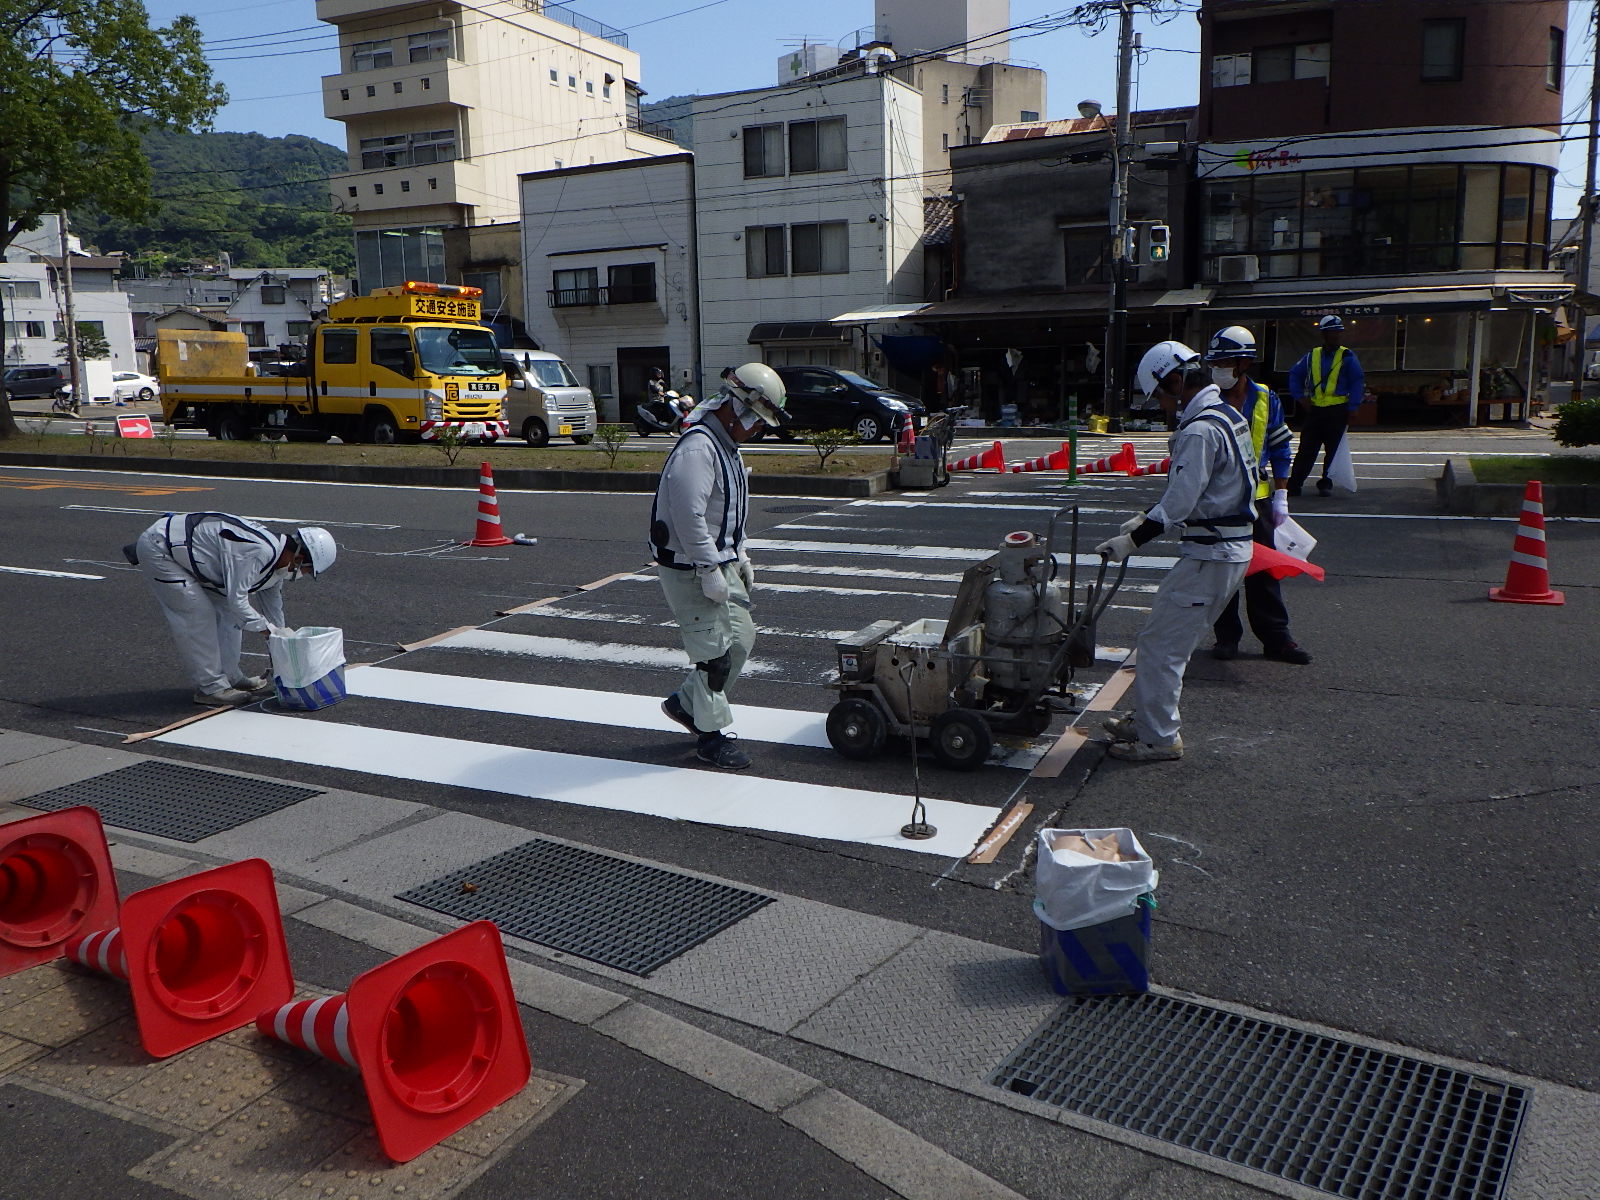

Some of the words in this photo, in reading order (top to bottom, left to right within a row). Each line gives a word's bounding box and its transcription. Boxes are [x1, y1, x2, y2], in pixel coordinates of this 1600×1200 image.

[415, 298, 477, 318] 交通安全施設
[446, 383, 459, 401] 危
[470, 383, 497, 391] 高圧ガス
